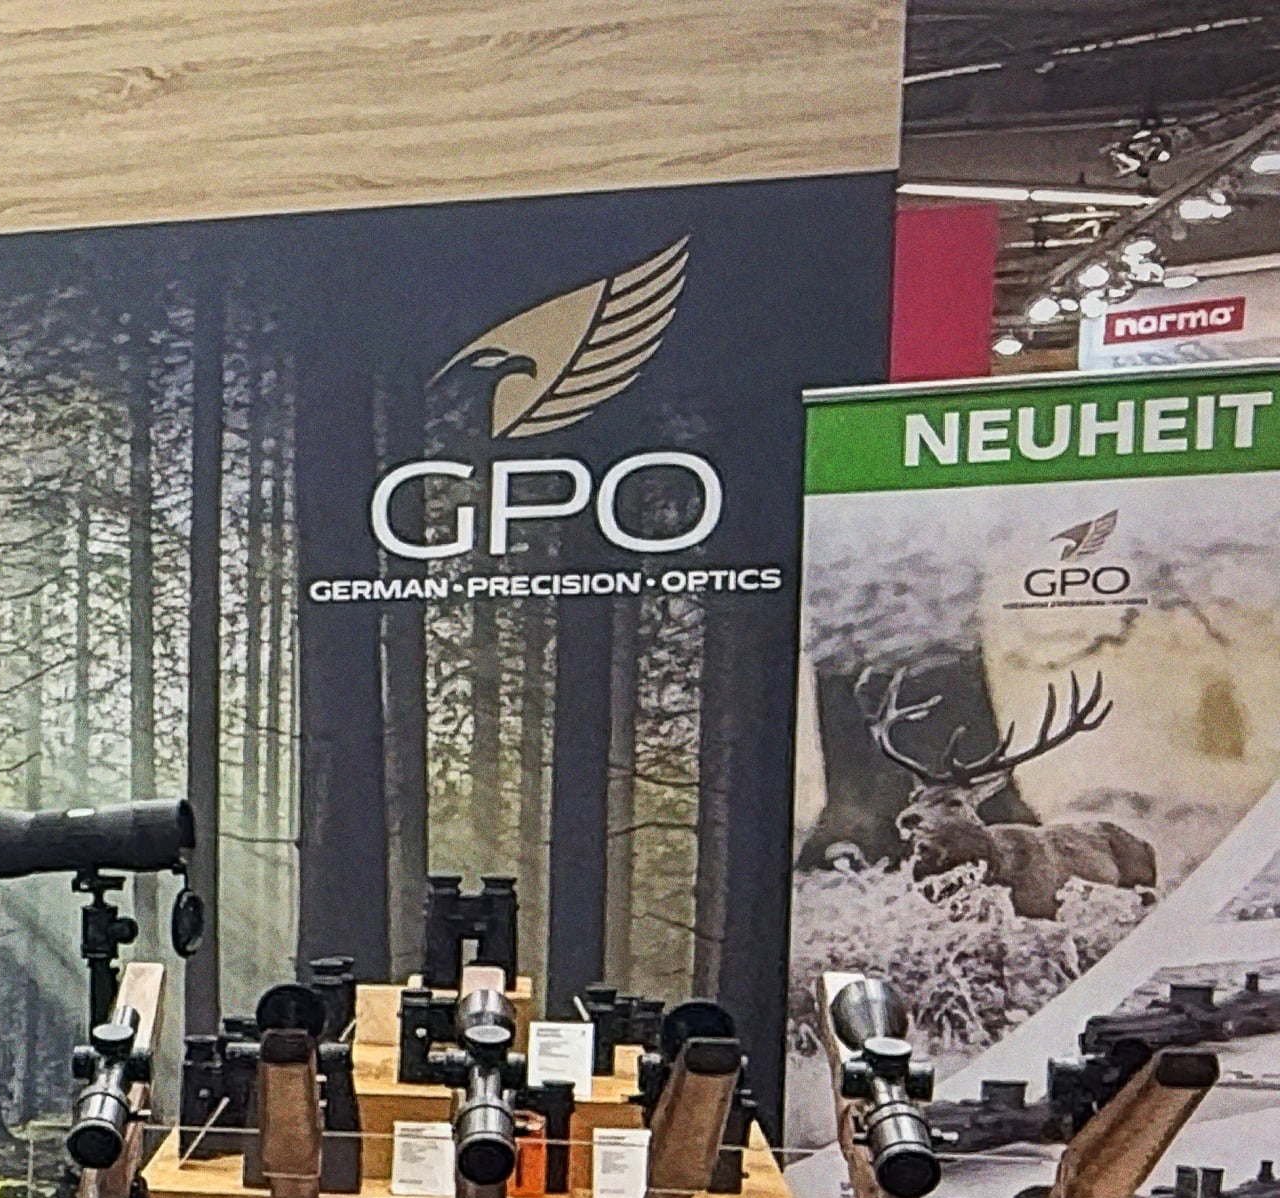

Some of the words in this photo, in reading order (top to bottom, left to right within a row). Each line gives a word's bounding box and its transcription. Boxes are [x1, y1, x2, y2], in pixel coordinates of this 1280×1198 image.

[904, 391, 1273, 467] NEUHEIT
[371, 450, 724, 560] GPO
[309, 578, 450, 601] GERMAN
[466, 572, 641, 598] PRECISION
[662, 568, 783, 593] OPTICS
[1024, 566, 1131, 597] GPO
